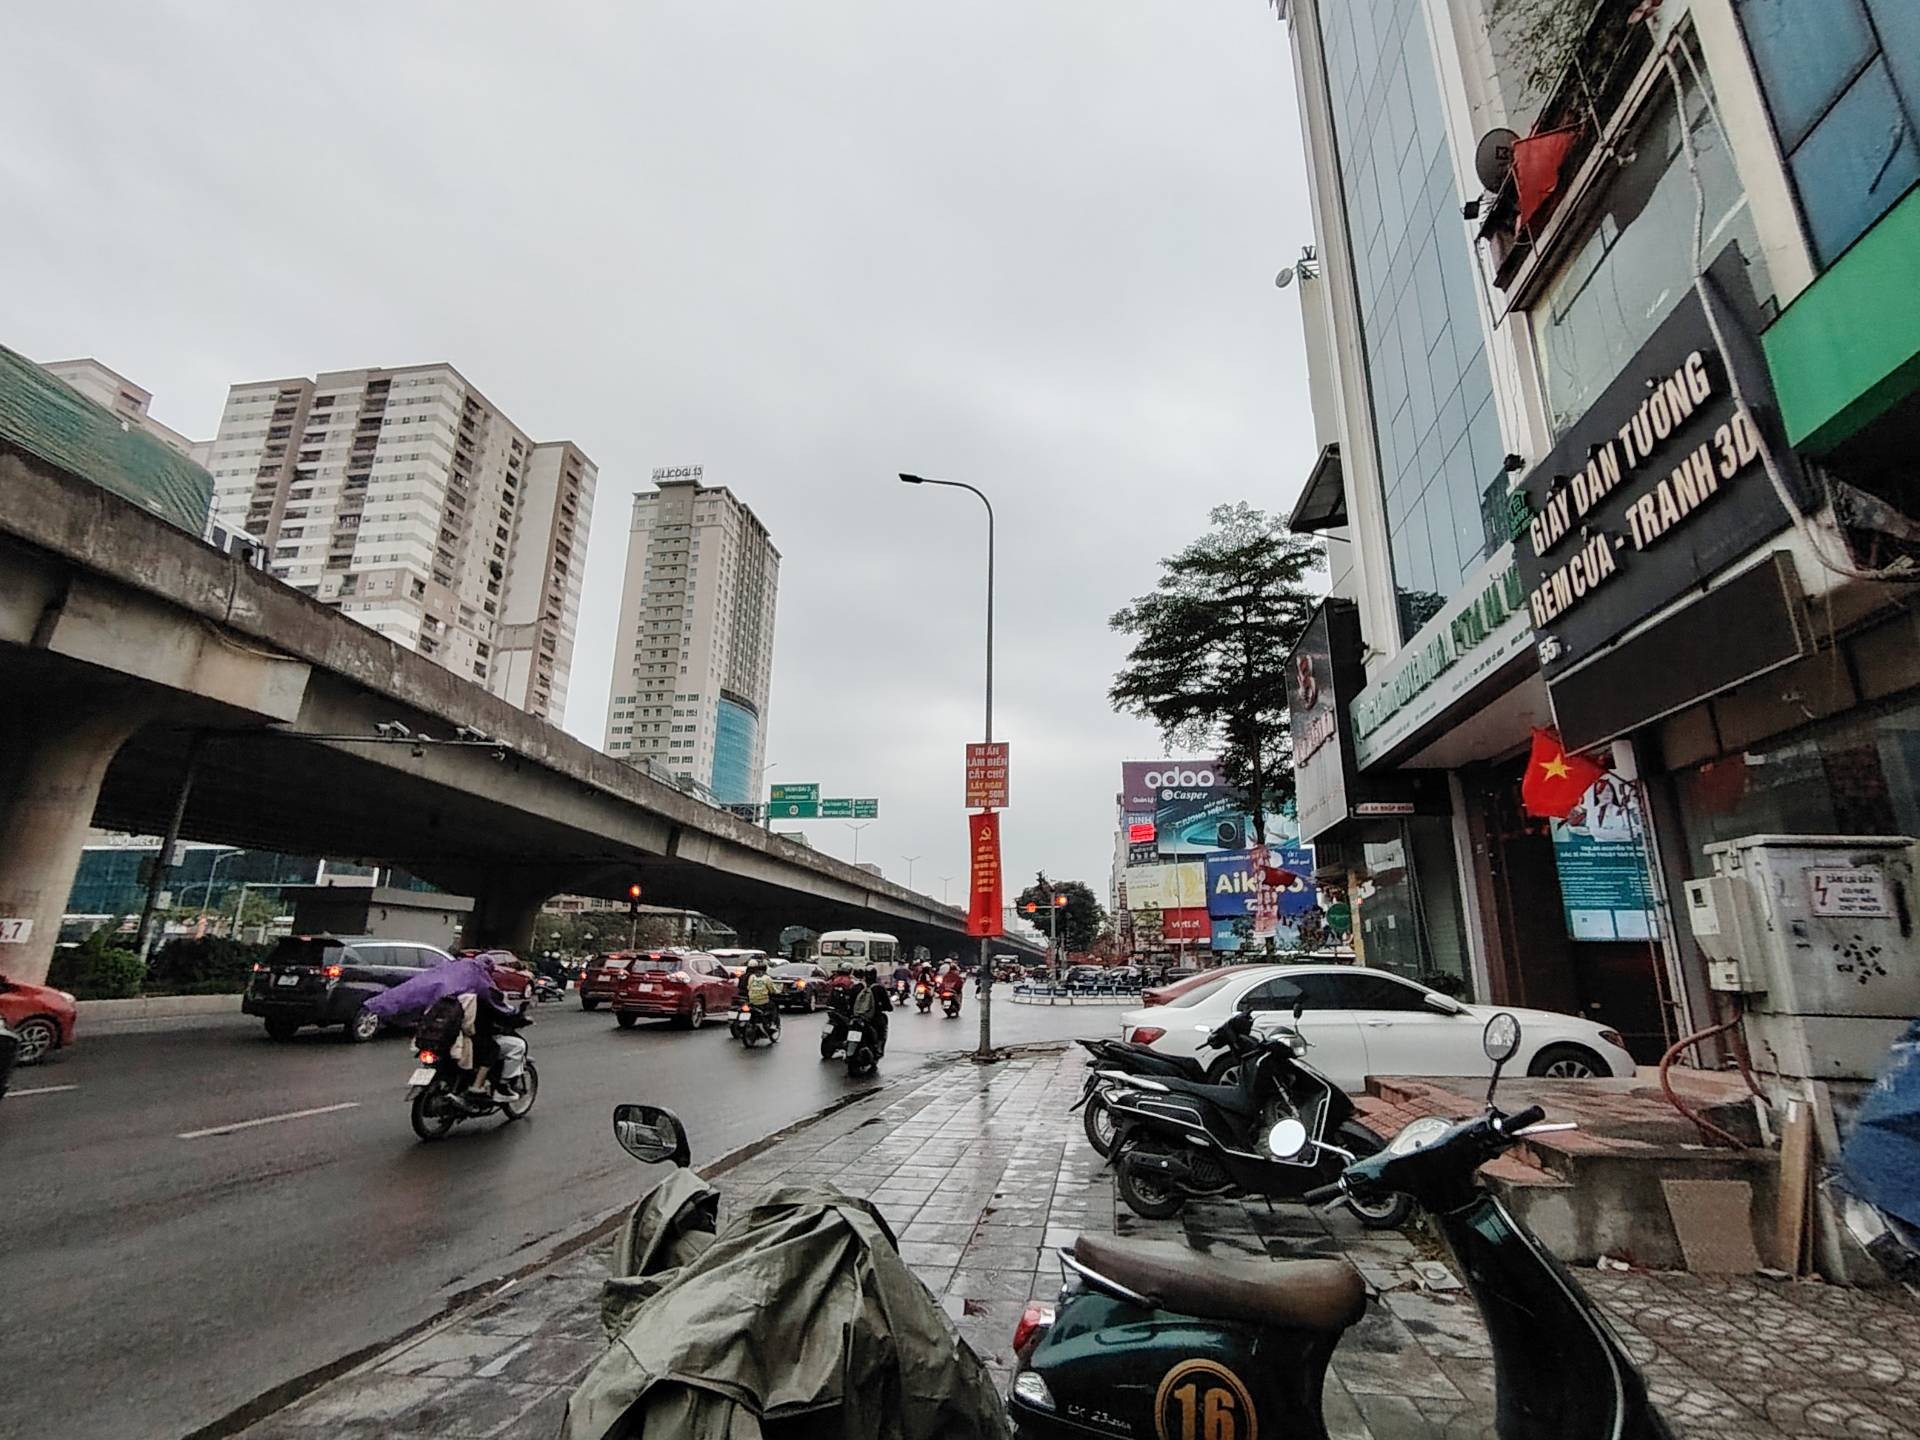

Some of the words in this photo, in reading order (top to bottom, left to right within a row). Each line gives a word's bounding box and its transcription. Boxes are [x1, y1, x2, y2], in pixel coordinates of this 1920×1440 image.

[1571, 442, 1621, 517] DÁN
[1618, 350, 1711, 469] TƯỜNG
[1530, 564, 1573, 629] RÈM
[1570, 526, 1616, 598] CỬA
[1625, 442, 1719, 551] TRANH
[1714, 408, 1758, 480] 3D
[1144, 765, 1215, 789] odoo
[1173, 790, 1208, 802] Casper
[1174, 1384, 1235, 1440] 16
